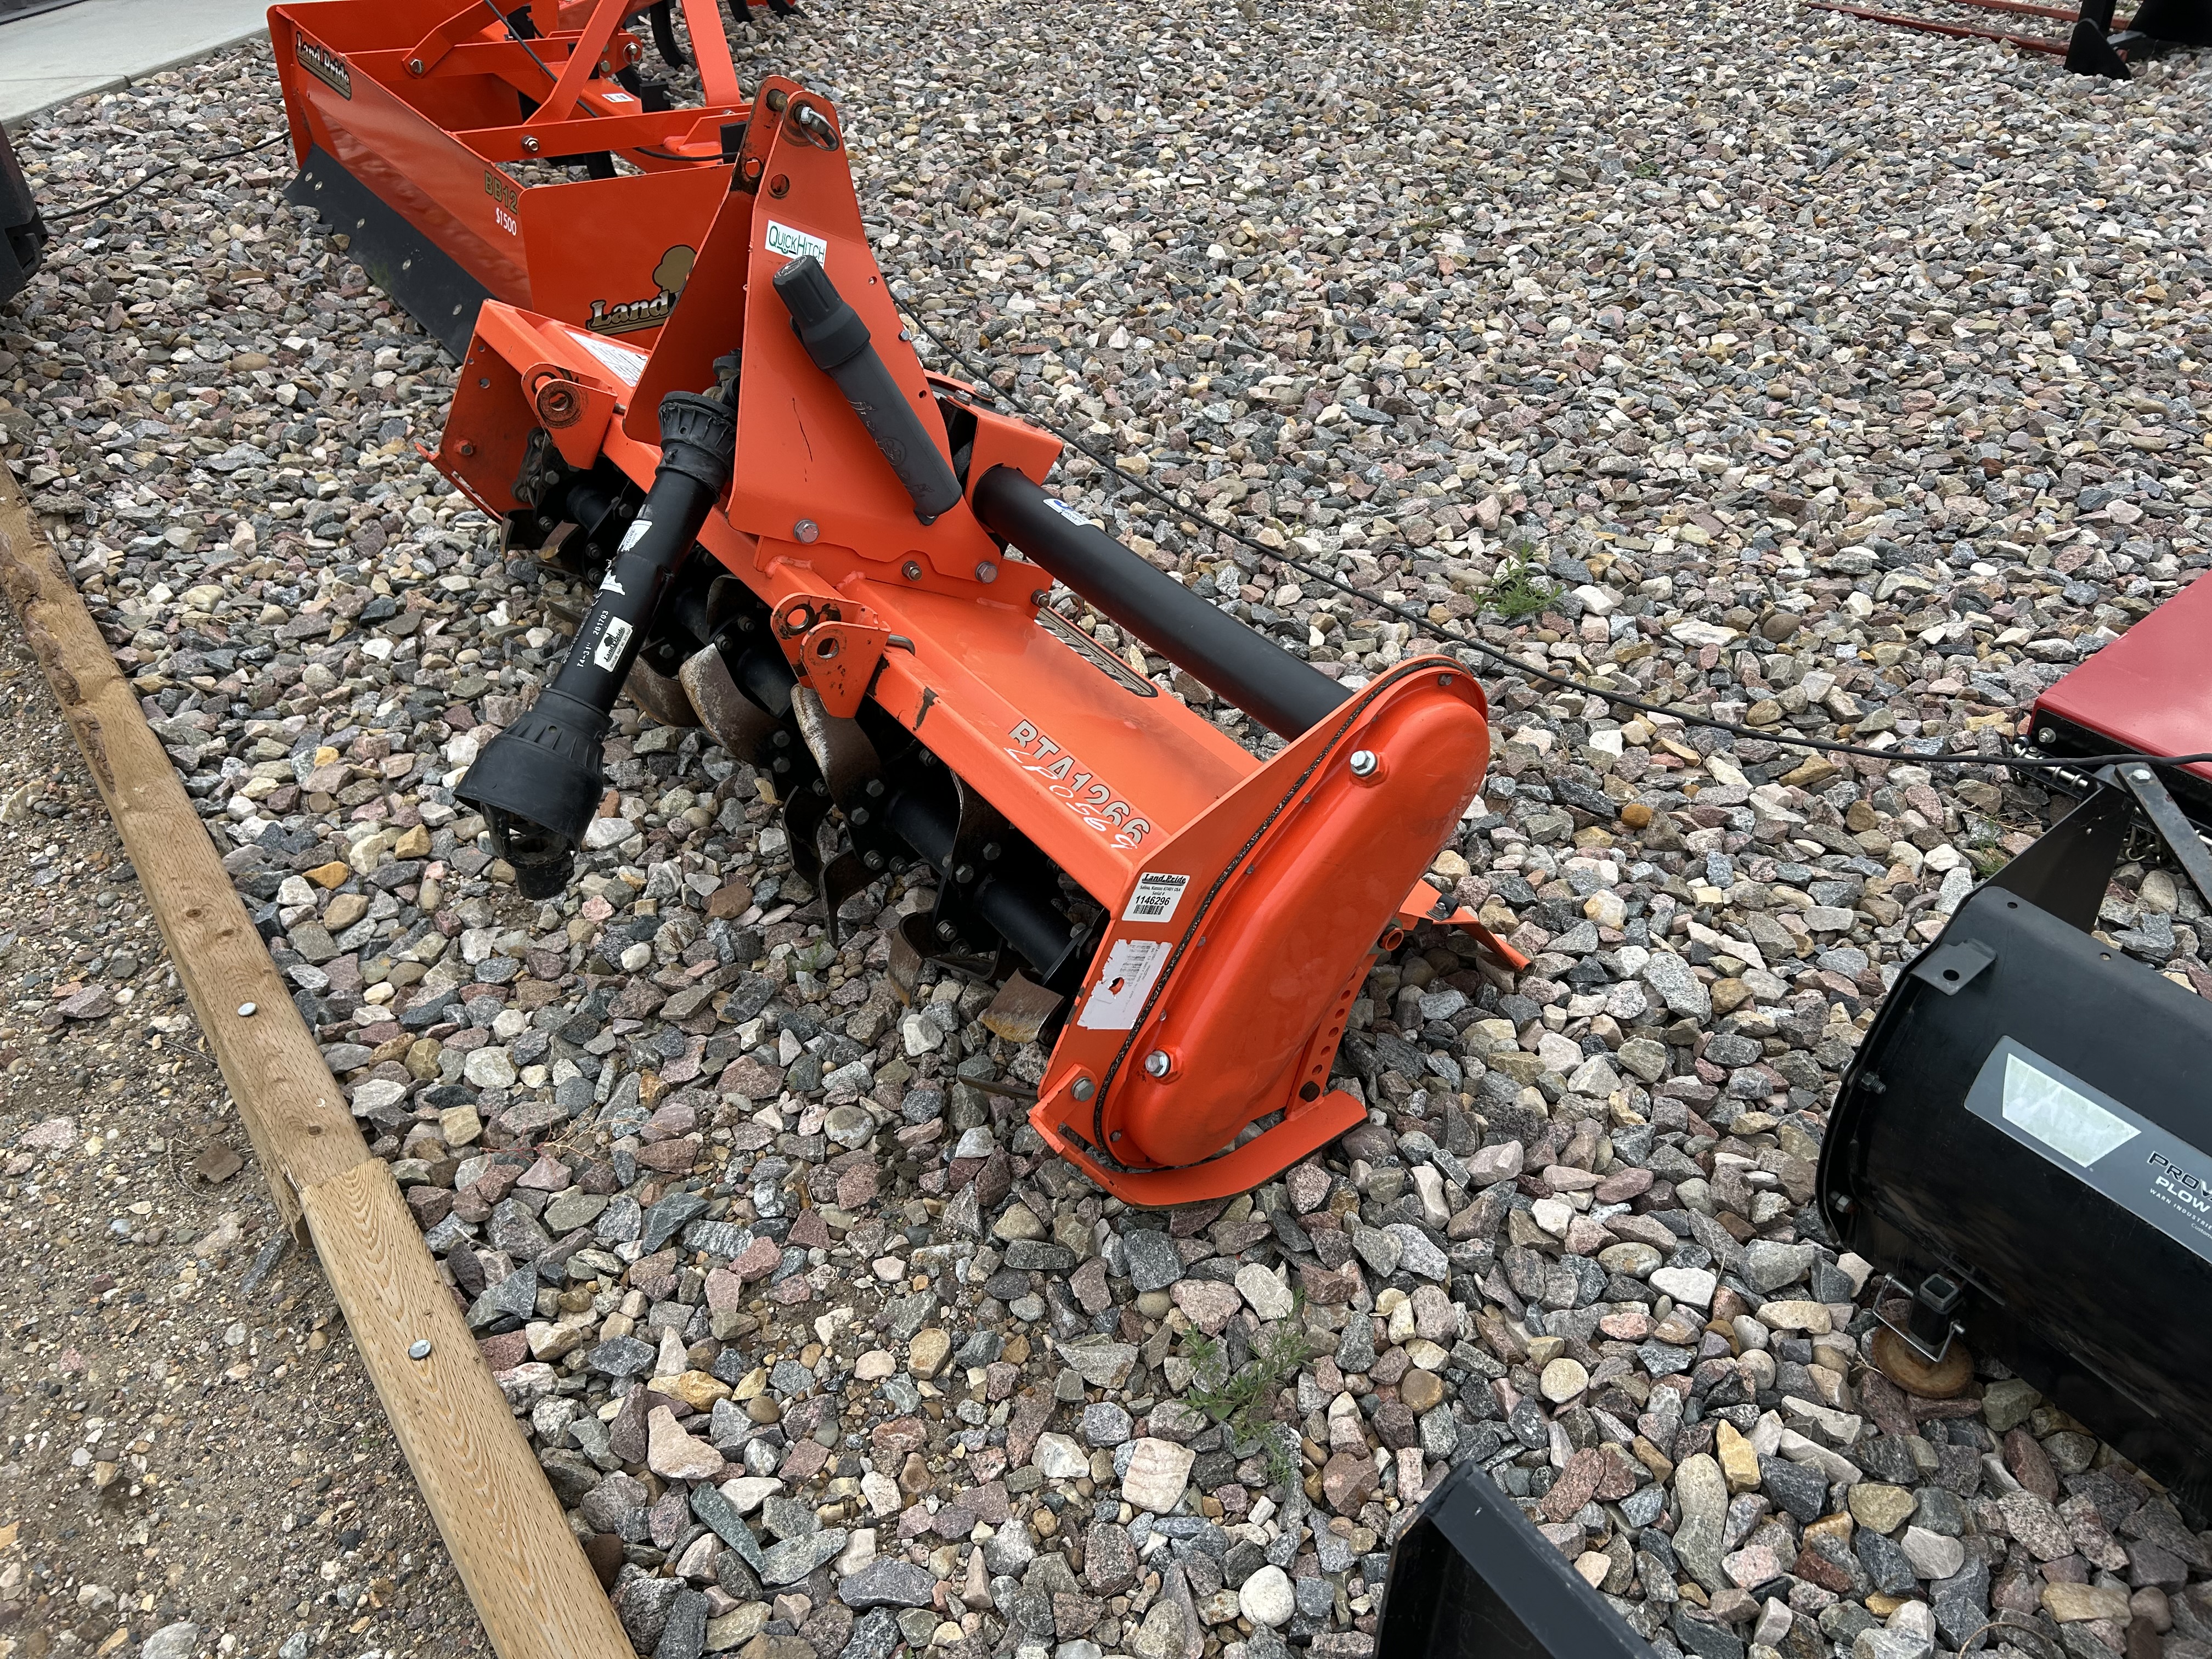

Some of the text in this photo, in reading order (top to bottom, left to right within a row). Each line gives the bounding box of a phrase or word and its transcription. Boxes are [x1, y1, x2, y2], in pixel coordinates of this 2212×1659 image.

[296, 31, 350, 91] Land Pride
[495, 207, 517, 236] $1500
[589, 290, 670, 328] Land
[592, 610, 609, 635] 201703
[1008, 719, 1150, 844] RTA1266
[1143, 873, 1186, 884] Land Pride
[1135, 895, 1171, 906] 1146296
[2147, 1150, 2212, 1203] PROV
[2149, 1188, 2171, 1204] WARN
[2155, 1175, 2210, 1213] PLOW
